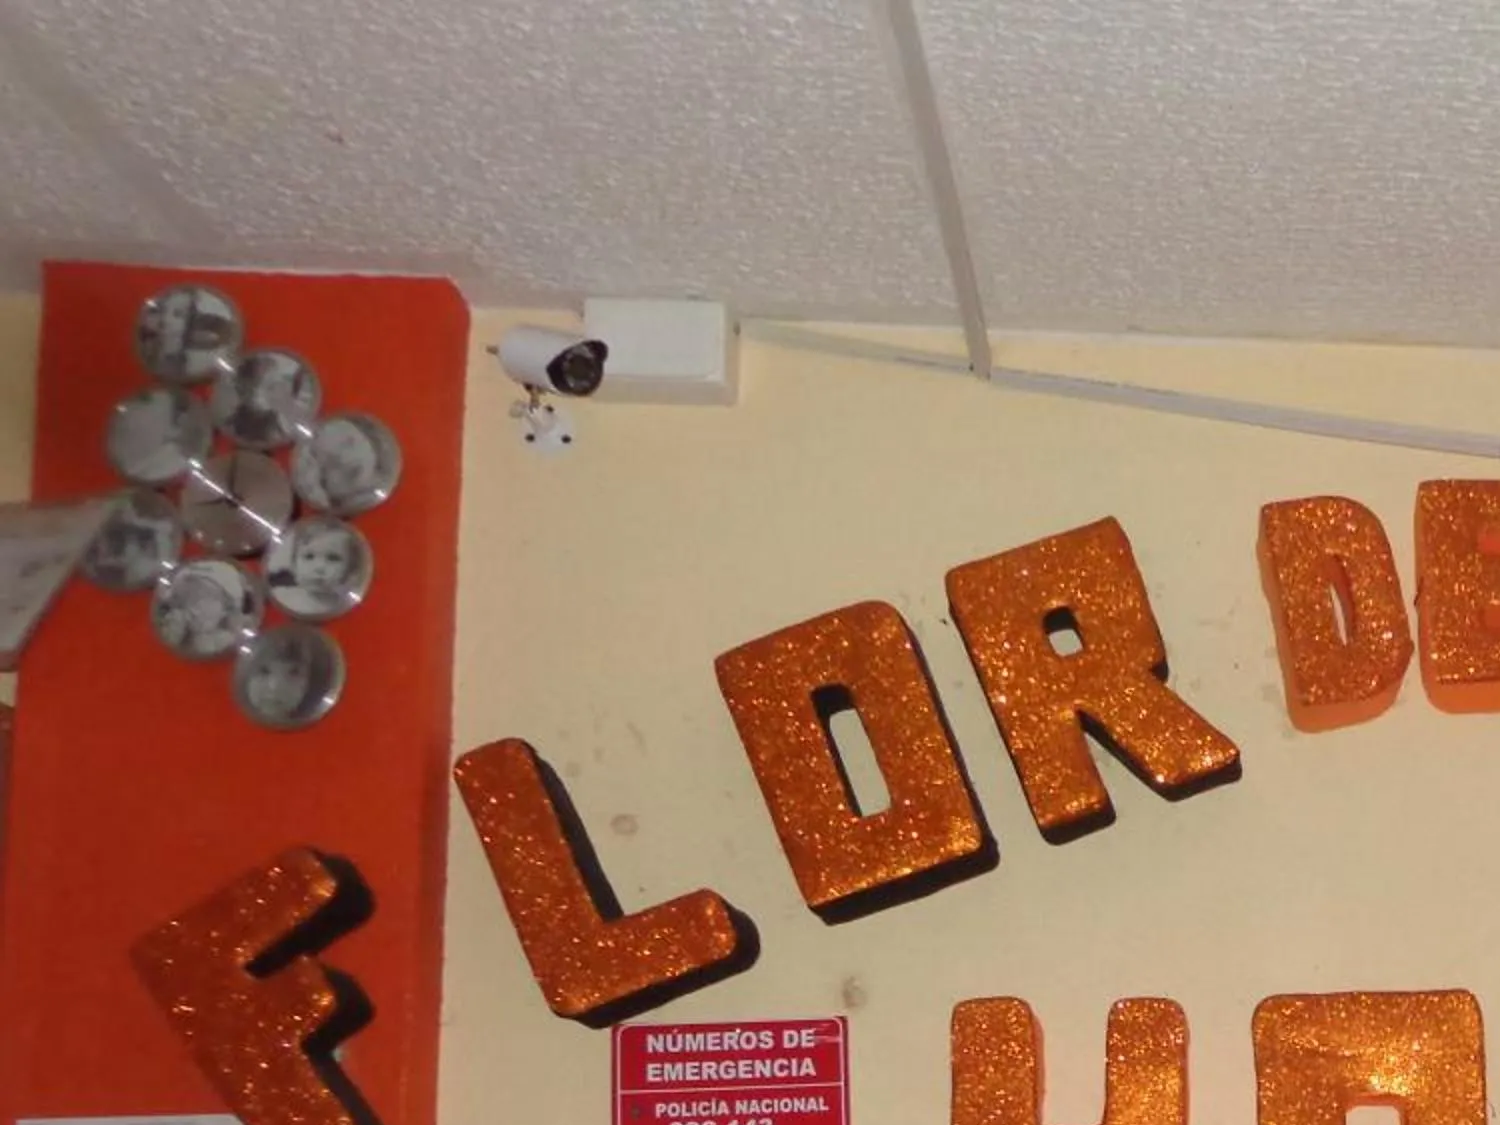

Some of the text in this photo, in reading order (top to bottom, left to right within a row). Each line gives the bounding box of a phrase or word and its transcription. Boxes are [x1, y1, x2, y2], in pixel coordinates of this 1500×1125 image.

[647, 1028, 816, 1054] NÚMEROS DE
[647, 1057, 817, 1082] EMERGENCIA
[655, 1096, 830, 1118] POLICÍA NACIONAL
